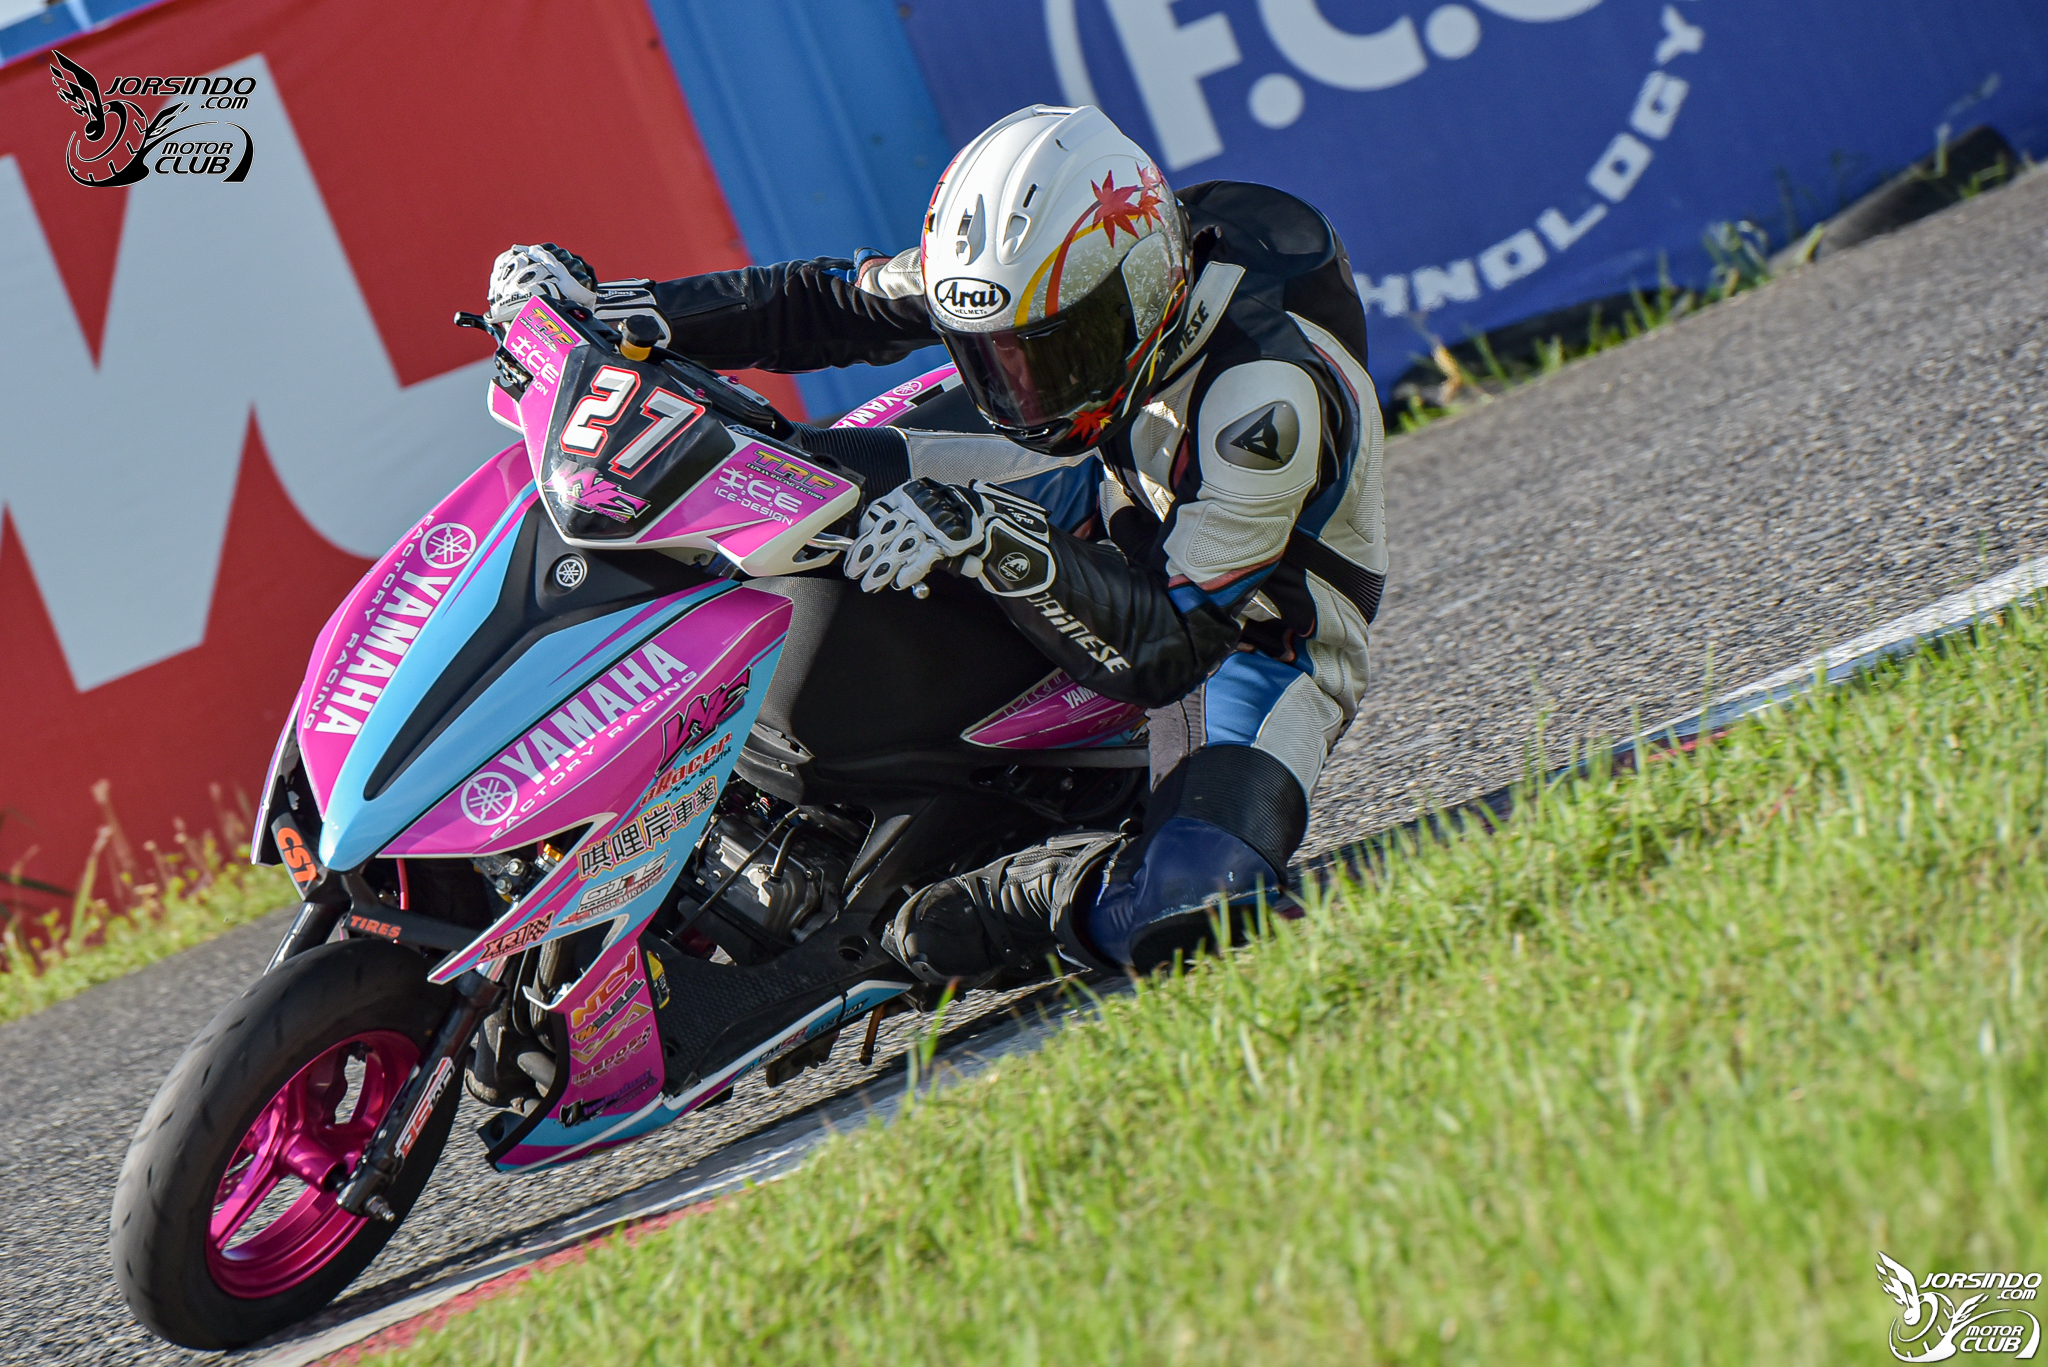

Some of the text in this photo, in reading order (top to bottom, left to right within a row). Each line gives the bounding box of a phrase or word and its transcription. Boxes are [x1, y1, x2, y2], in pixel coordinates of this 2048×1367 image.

[1352, 5, 1703, 317] HNOLOGY
[526, 306, 577, 345] TRF
[938, 281, 1000, 308] Arai
[559, 365, 706, 480] 27
[714, 487, 794, 526] ICE-DESIGN
[746, 462, 827, 501] TAIWAN RACING FACTORY
[754, 448, 839, 490] TRF
[303, 513, 435, 730] FACTORY RACING
[314, 570, 453, 736] YAMAHA
[498, 641, 689, 785] YAMAHA
[489, 744, 595, 840] FACTORY
[606, 670, 698, 740] RACING
[639, 731, 732, 807] aRacer
[276, 826, 318, 883] CST
[579, 777, 717, 878] 唭哩岸車業
[350, 914, 402, 938] TIRES
